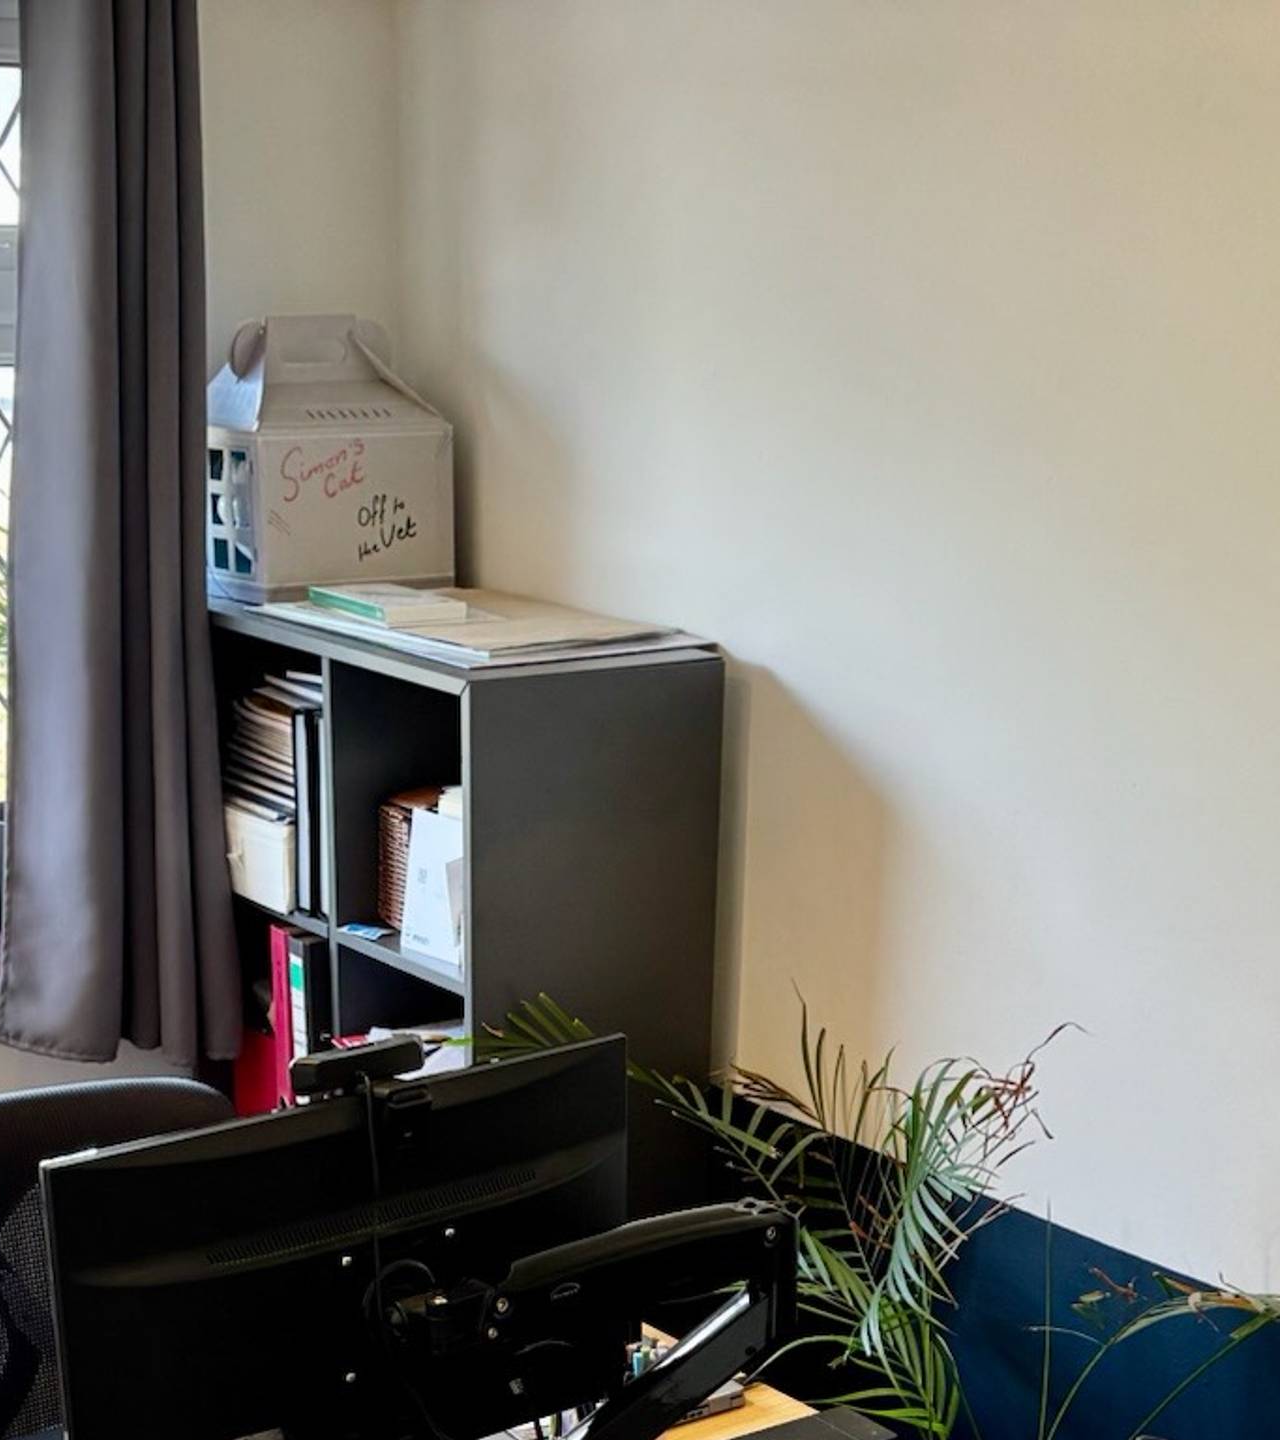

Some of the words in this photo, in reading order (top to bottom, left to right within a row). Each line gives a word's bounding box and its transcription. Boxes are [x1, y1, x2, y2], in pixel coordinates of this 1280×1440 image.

[280, 437, 365, 502] Simon's
[324, 460, 365, 498] Cat
[357, 493, 387, 528] Off
[392, 497, 406, 515] to
[357, 540, 381, 562] the
[379, 515, 418, 548] Vet
